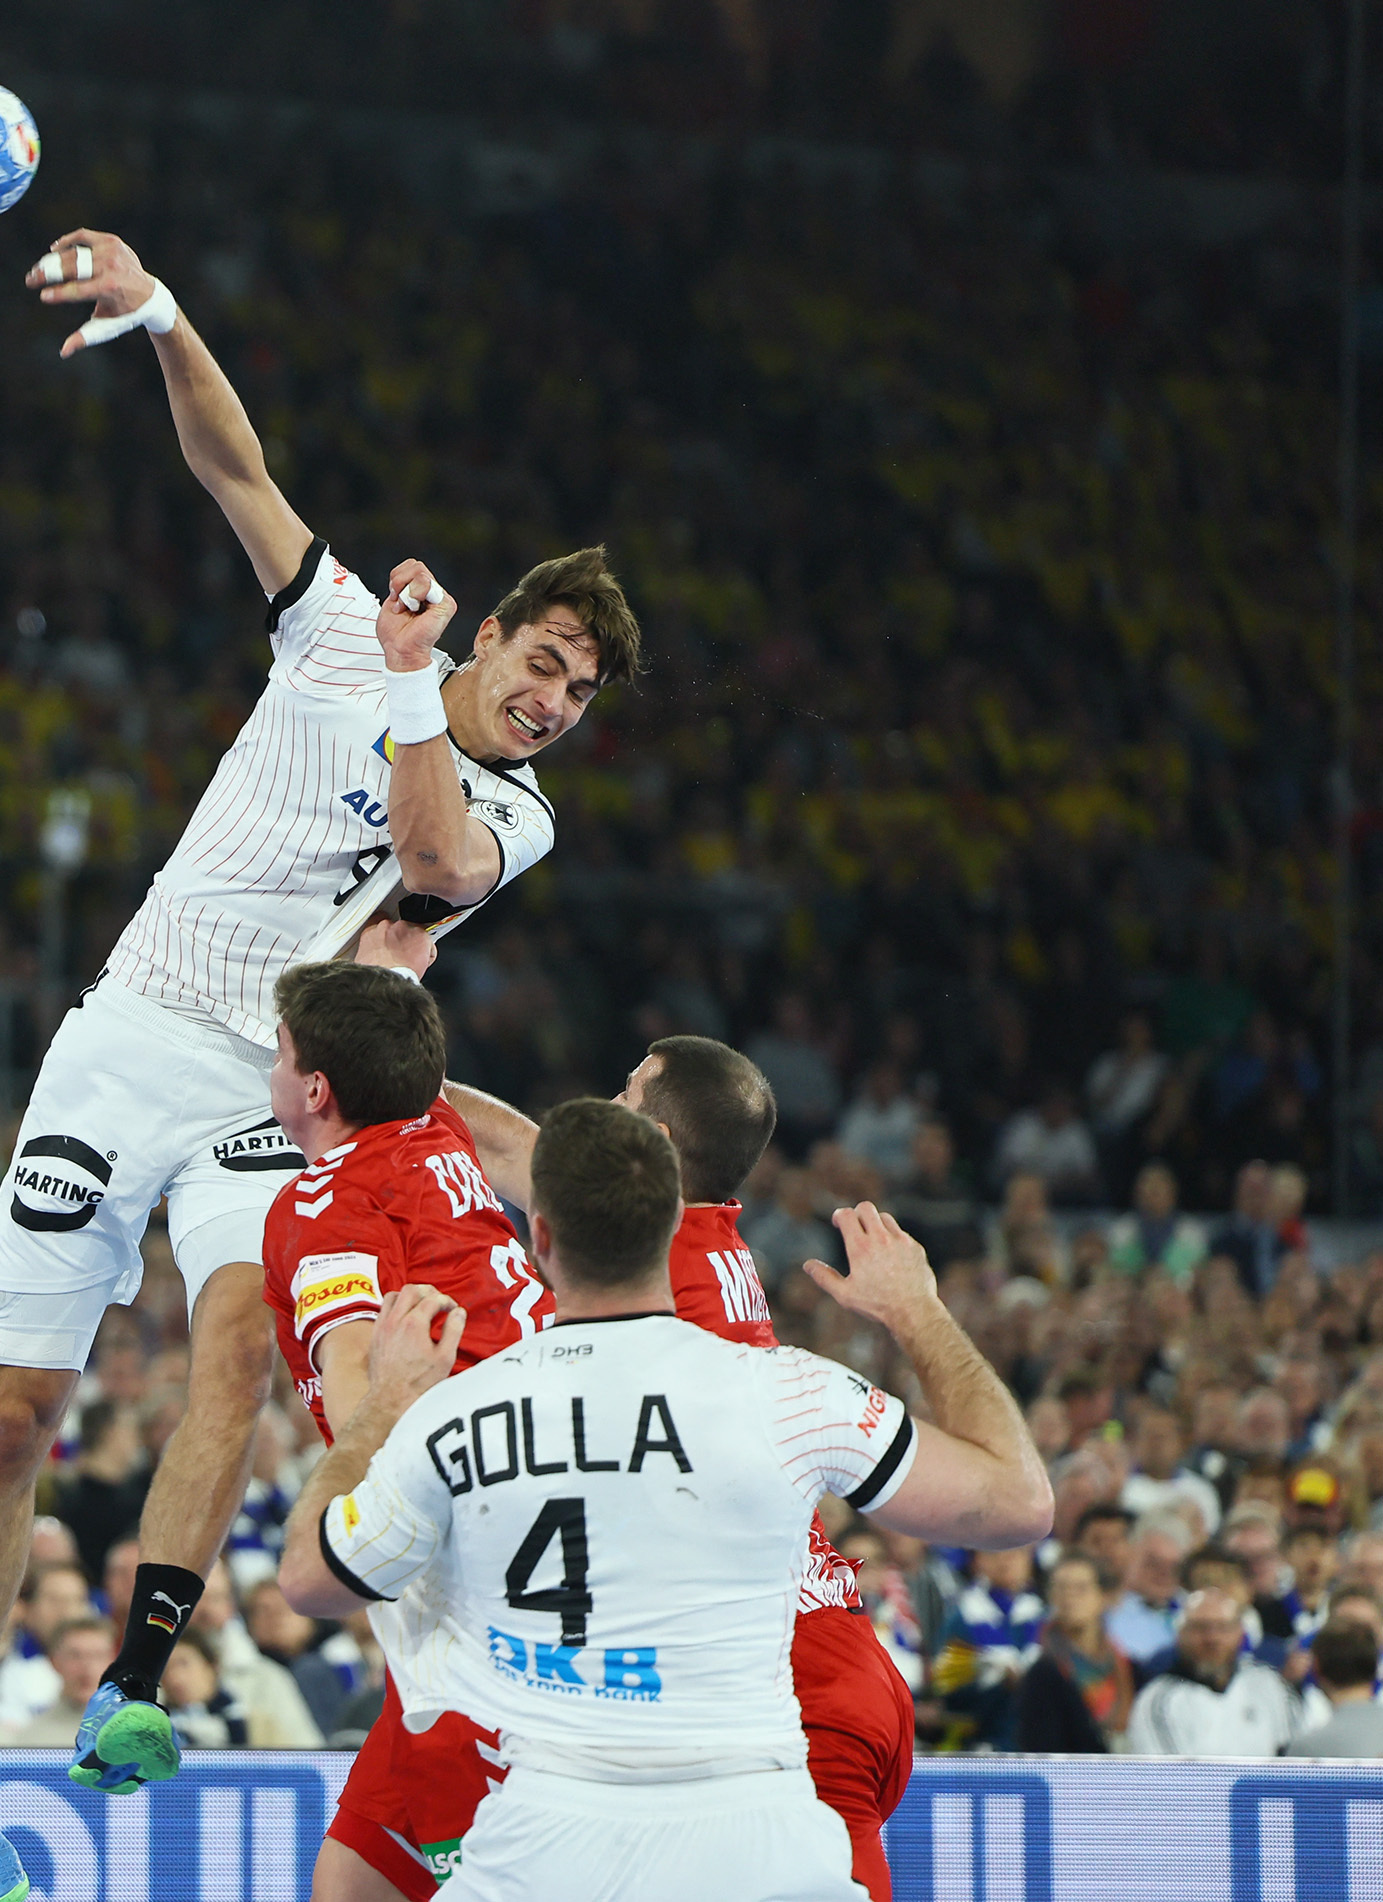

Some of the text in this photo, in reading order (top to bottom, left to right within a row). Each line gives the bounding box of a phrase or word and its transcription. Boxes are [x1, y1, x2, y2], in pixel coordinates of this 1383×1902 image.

[213, 1135, 293, 1160] HARTI
[14, 1165, 105, 1205] HARTING
[426, 1394, 694, 1498] GOLLA
[504, 1497, 593, 1647] 4
